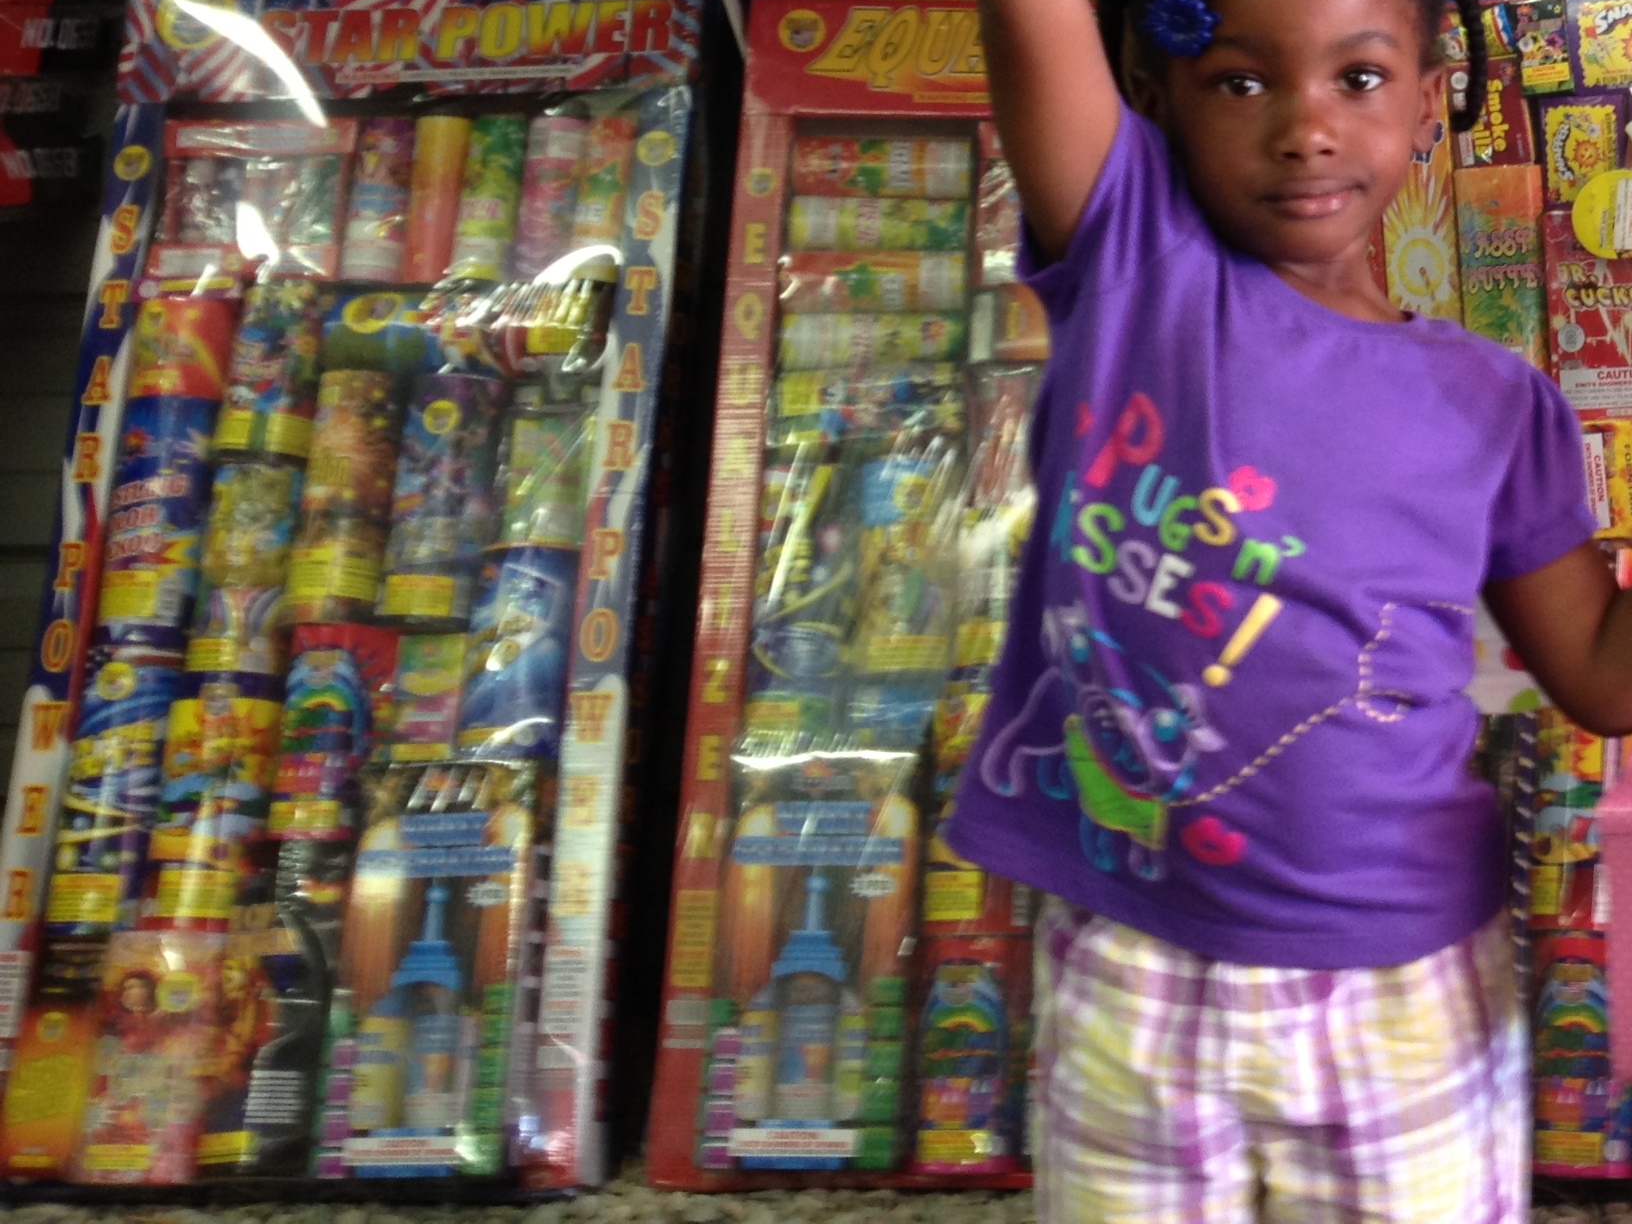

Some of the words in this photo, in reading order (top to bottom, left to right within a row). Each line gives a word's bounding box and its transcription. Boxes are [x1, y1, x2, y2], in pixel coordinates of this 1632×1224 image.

[260, 10, 424, 66] STAR
[1488, 79, 1509, 153] Smoke
[1084, 391, 1243, 552] PUGS
[1594, 454, 1605, 503] CAUTION
